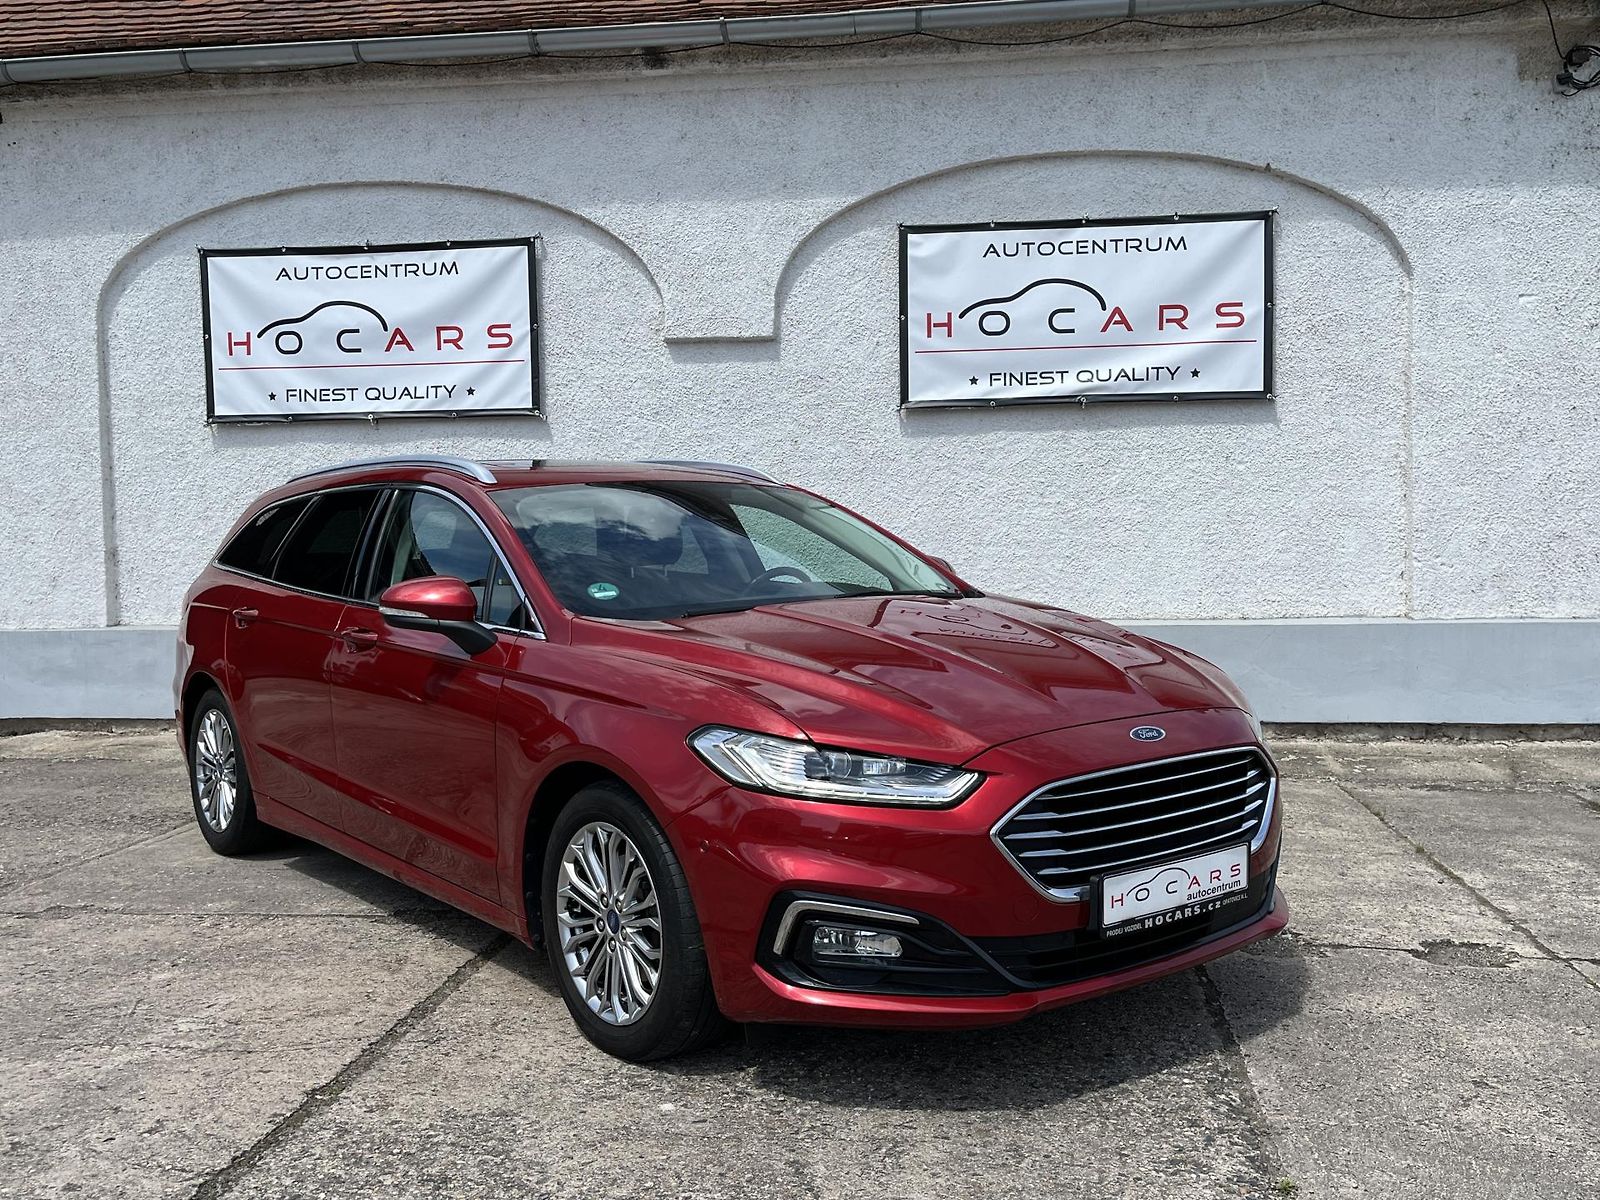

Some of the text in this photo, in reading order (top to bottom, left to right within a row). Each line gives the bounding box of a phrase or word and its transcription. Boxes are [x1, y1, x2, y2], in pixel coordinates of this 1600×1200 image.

[982, 236, 1187, 258] AUTOCENTRUM
[275, 261, 459, 281] AUTOCENTRUM
[989, 365, 1181, 387] FINEST QUALITY
[286, 384, 457, 403] FINEST QUALITY
[1138, 729, 1158, 738] Ford
[1186, 879, 1241, 901] autocentrum
